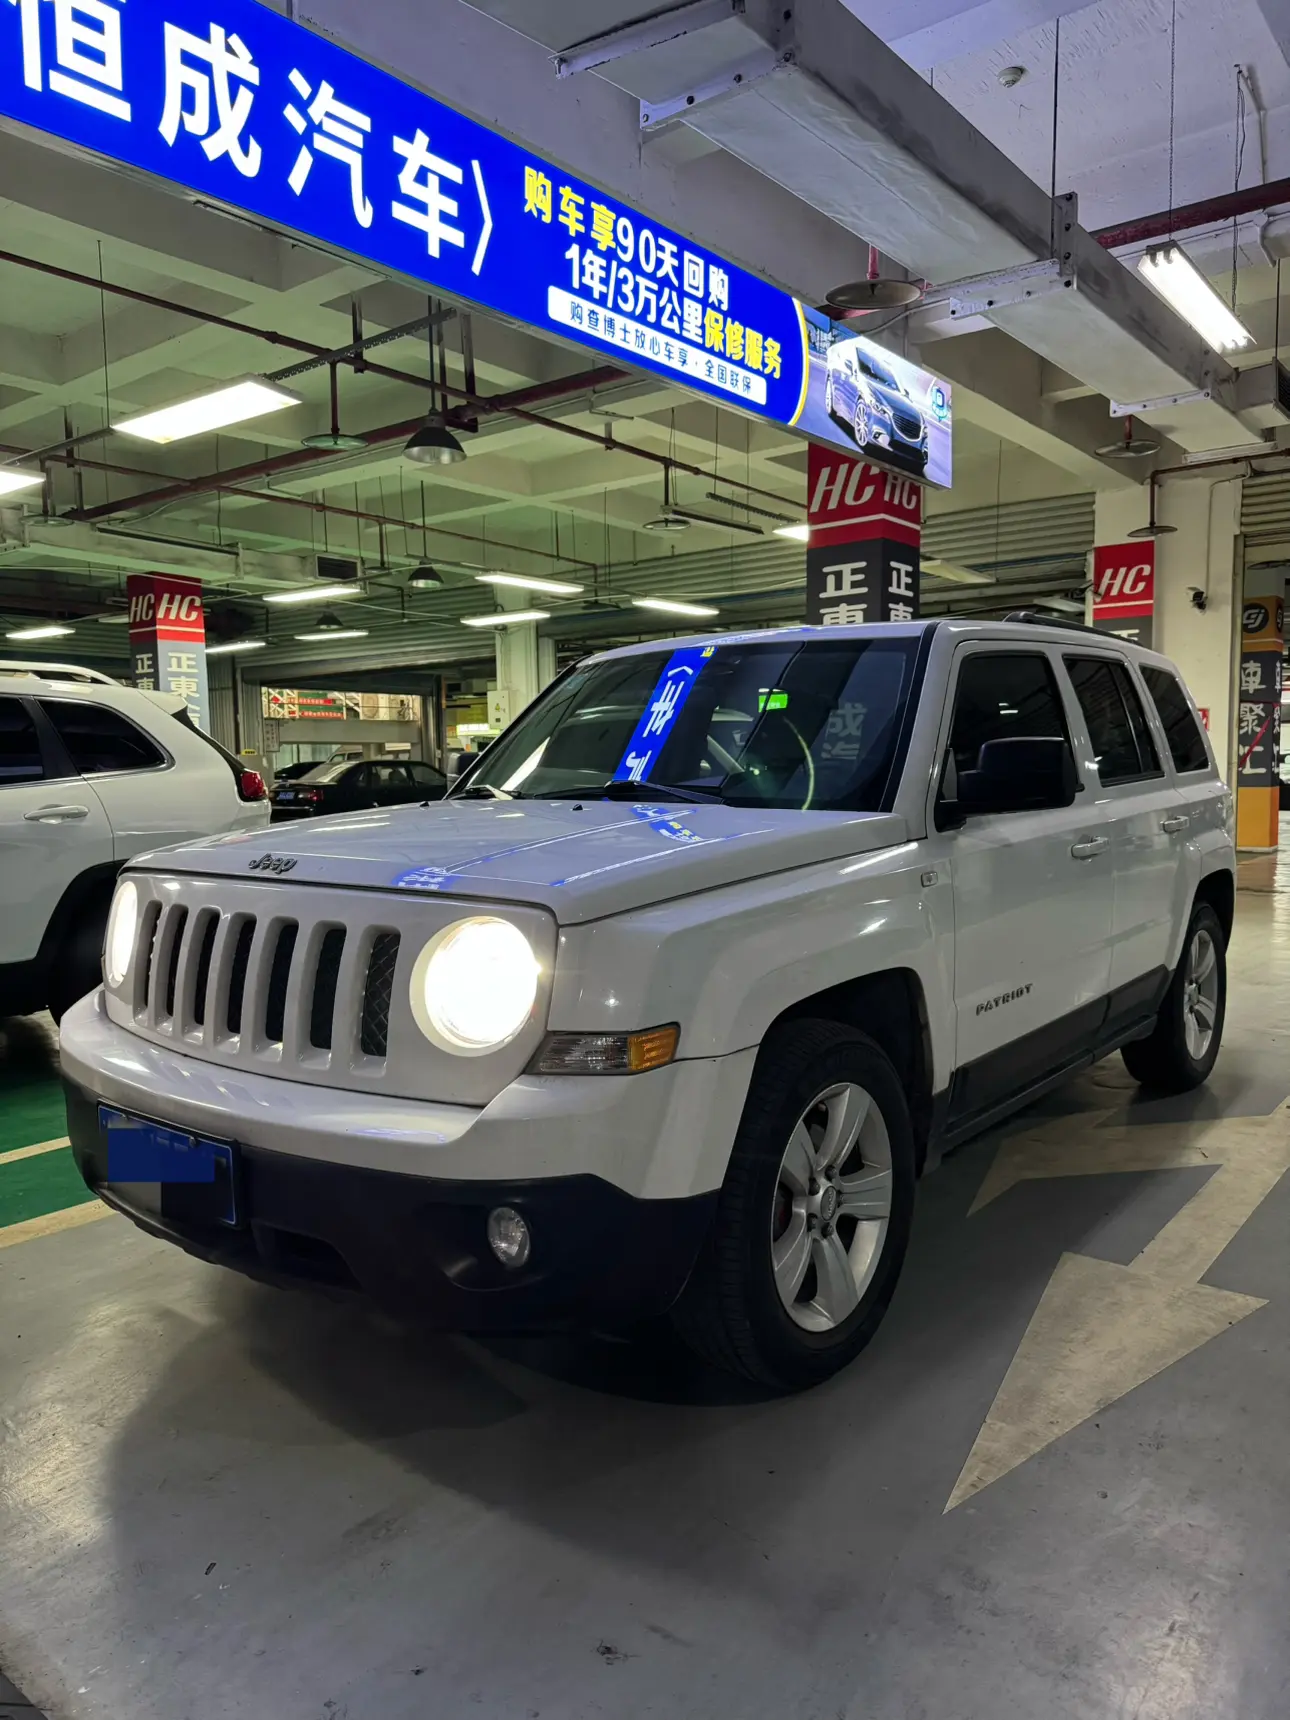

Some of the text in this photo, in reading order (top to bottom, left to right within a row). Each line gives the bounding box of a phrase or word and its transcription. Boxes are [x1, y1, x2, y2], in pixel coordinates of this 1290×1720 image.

[524, 165, 729, 311] 购车享90天回购
[565, 243, 782, 379] 1年/3万公里保修服务
[809, 461, 881, 513] HC
[883, 471, 918, 510] HC
[1097, 564, 1151, 597] HC
[129, 593, 155, 623] HC
[157, 592, 201, 621] HC
[248, 852, 298, 875] Jeep
[975, 983, 1033, 1016] PATRIOT
